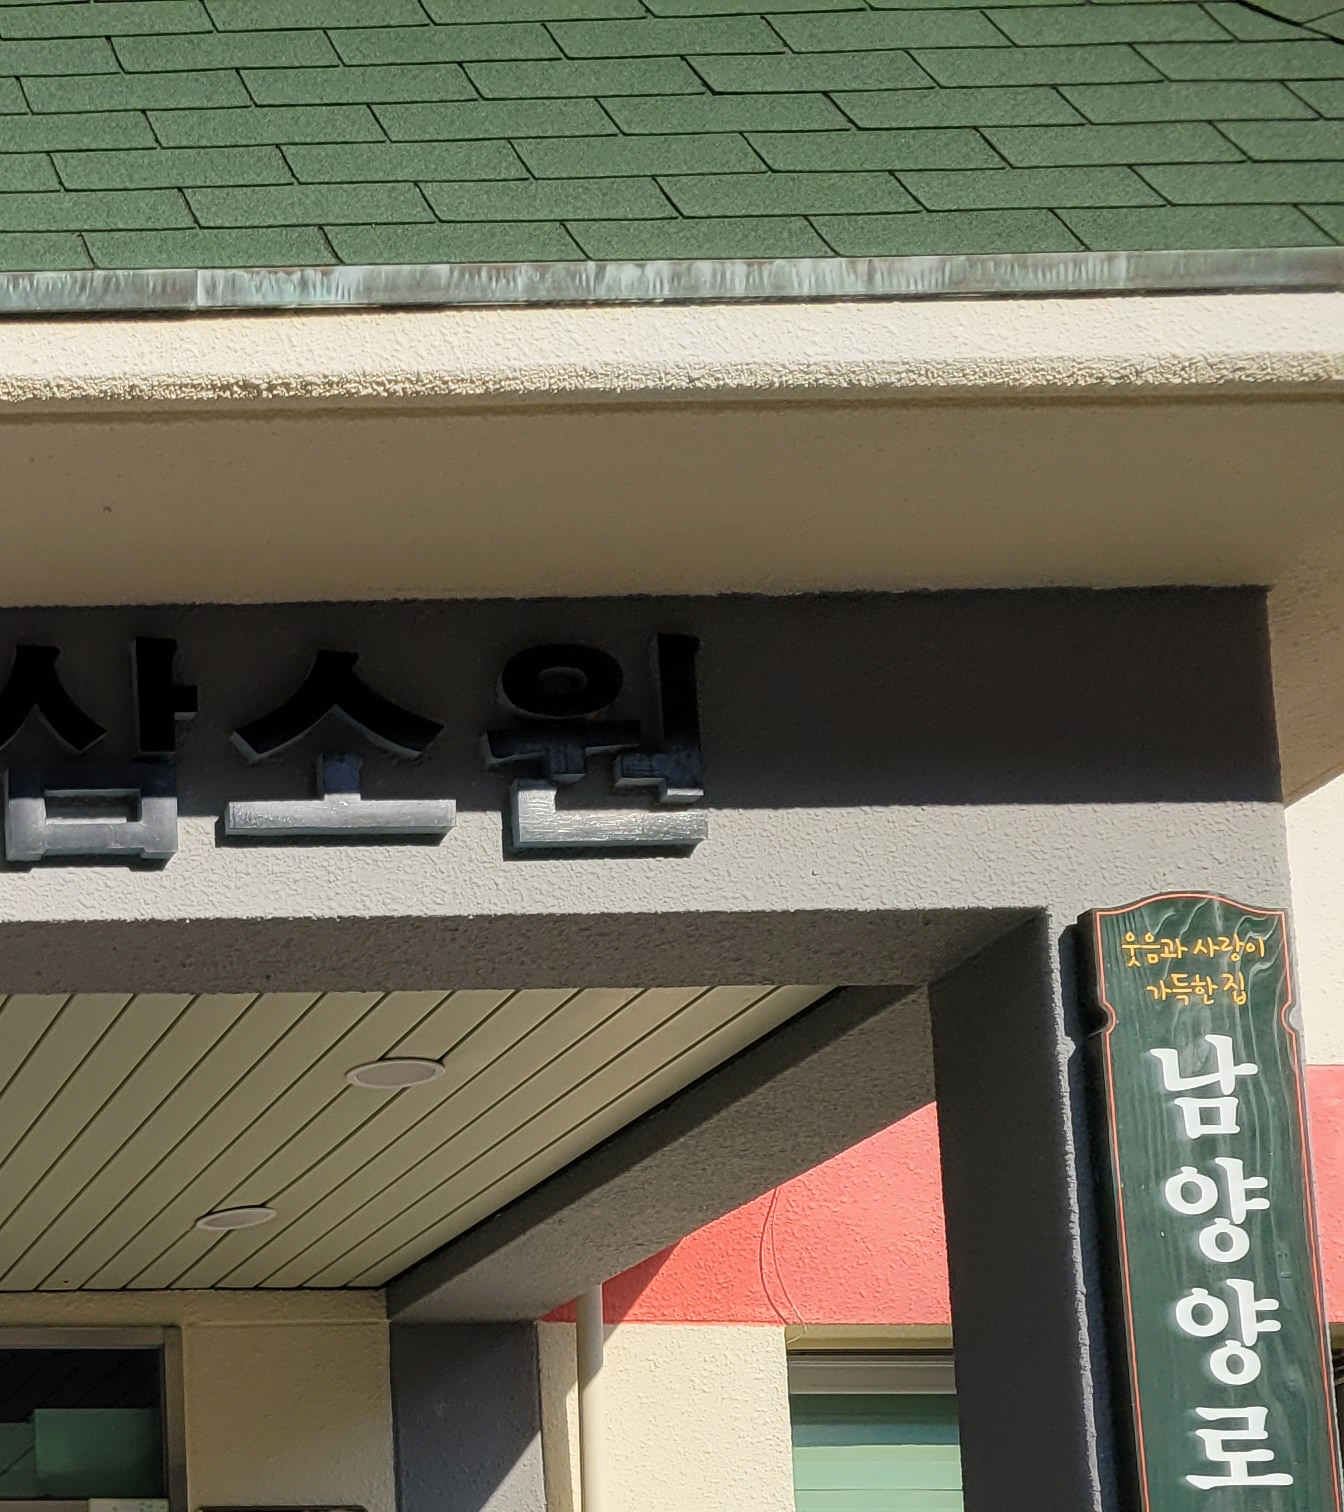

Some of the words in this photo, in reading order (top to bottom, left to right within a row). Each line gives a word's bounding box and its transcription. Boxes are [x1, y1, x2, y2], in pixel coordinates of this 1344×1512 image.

[1121, 931, 1189, 968] 웃음과
[1192, 933, 1266, 962] 사랑이
[1145, 973, 1219, 1006] 가득한
[1220, 971, 1248, 1006] 집
